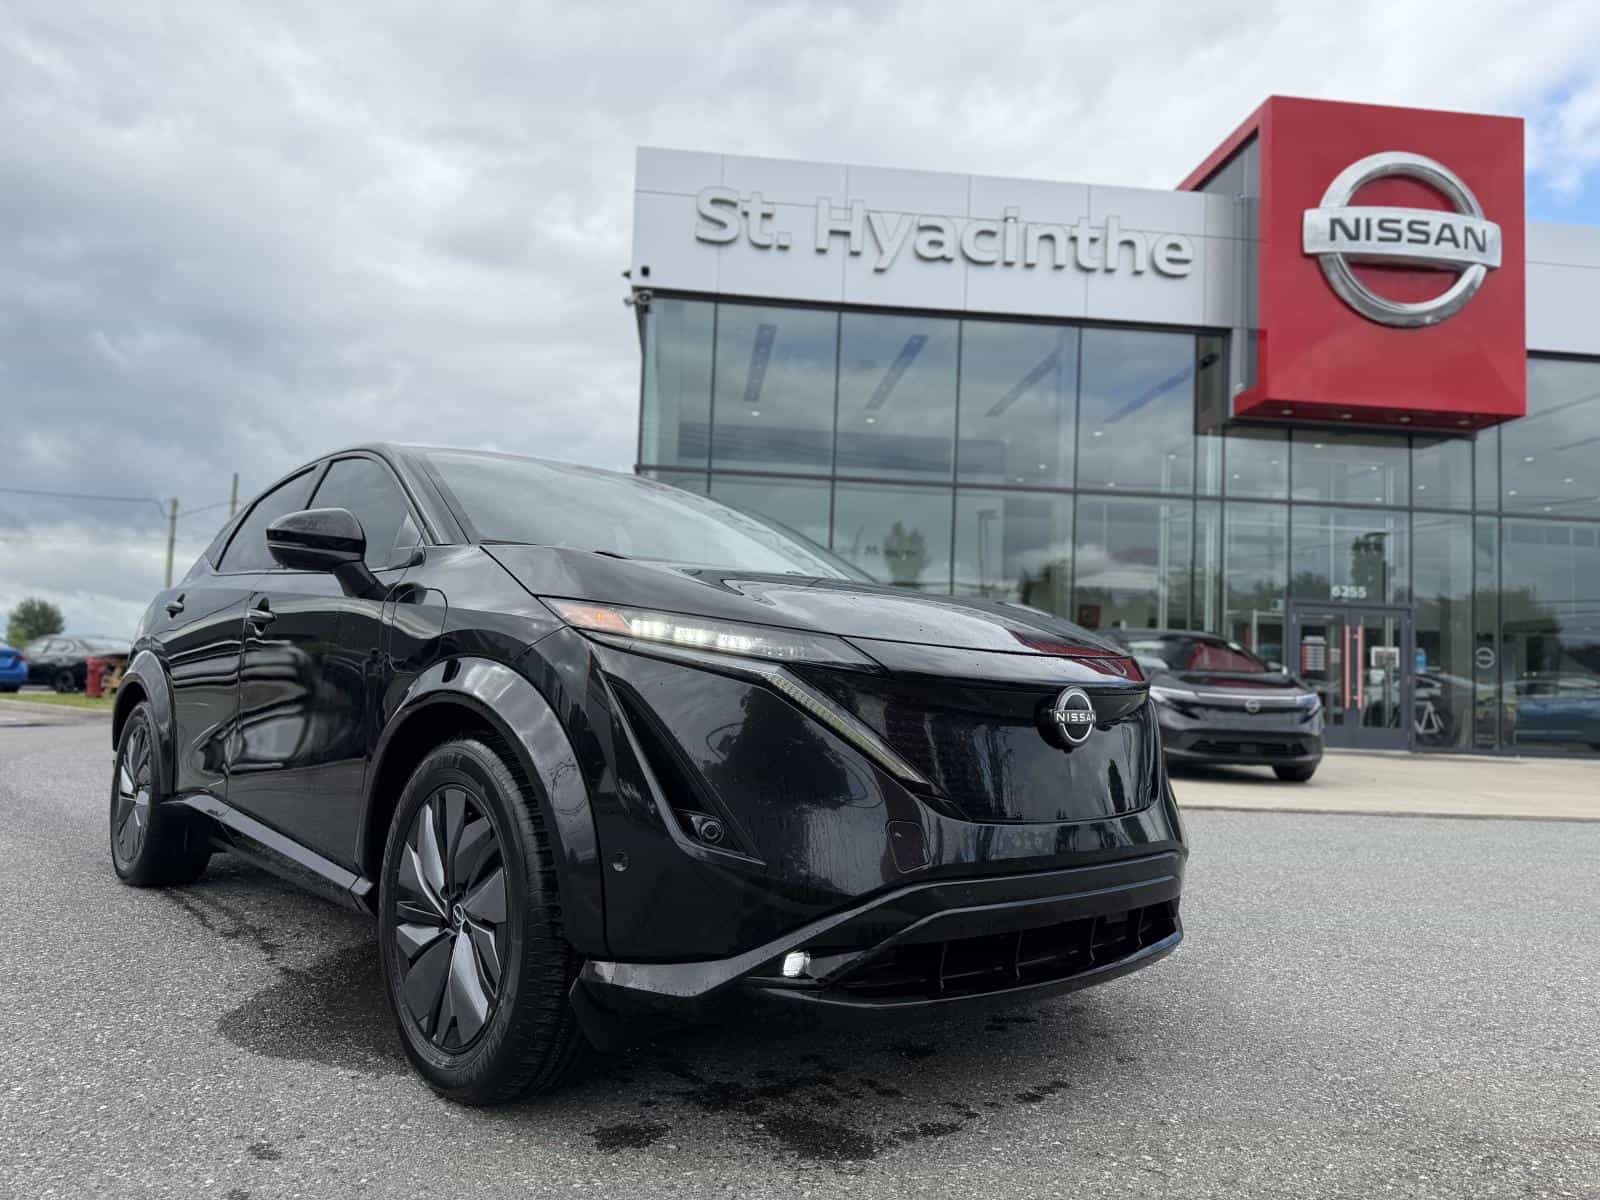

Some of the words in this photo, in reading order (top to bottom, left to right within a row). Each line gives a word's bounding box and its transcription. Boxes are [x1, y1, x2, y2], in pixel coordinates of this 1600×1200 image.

[695, 186, 792, 251] St.
[814, 197, 1194, 278] Hyacinthe
[1328, 217, 1487, 254] NISSAN
[1056, 712, 1096, 723] NISSAN
